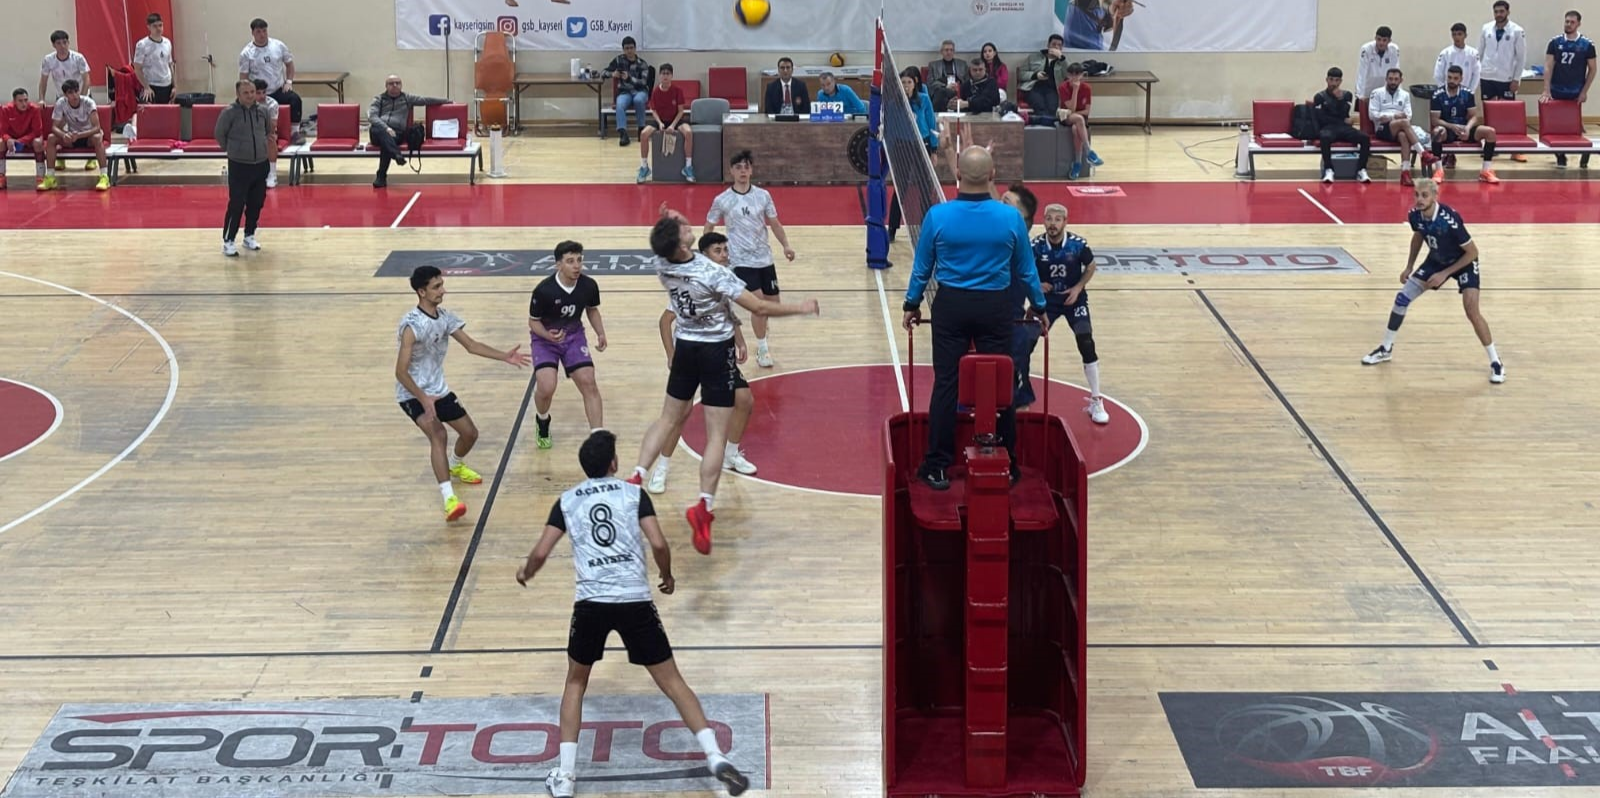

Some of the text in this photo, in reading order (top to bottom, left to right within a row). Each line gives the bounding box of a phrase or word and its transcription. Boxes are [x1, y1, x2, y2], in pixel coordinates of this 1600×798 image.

[522, 19, 562, 34] gsb_kayseri
[590, 20, 633, 34] GSB_Kayseri
[1561, 51, 1575, 66] 27
[1450, 107, 1458, 117] 9
[741, 206, 750, 216] 14
[1050, 264, 1067, 278] 23
[560, 305, 576, 318] 99
[1074, 305, 1088, 318] 23
[590, 503, 617, 548] 8
[1317, 765, 1374, 778] TBF
[34, 772, 385, 788] TEŞKİLAT BAŞKANLIĞI
